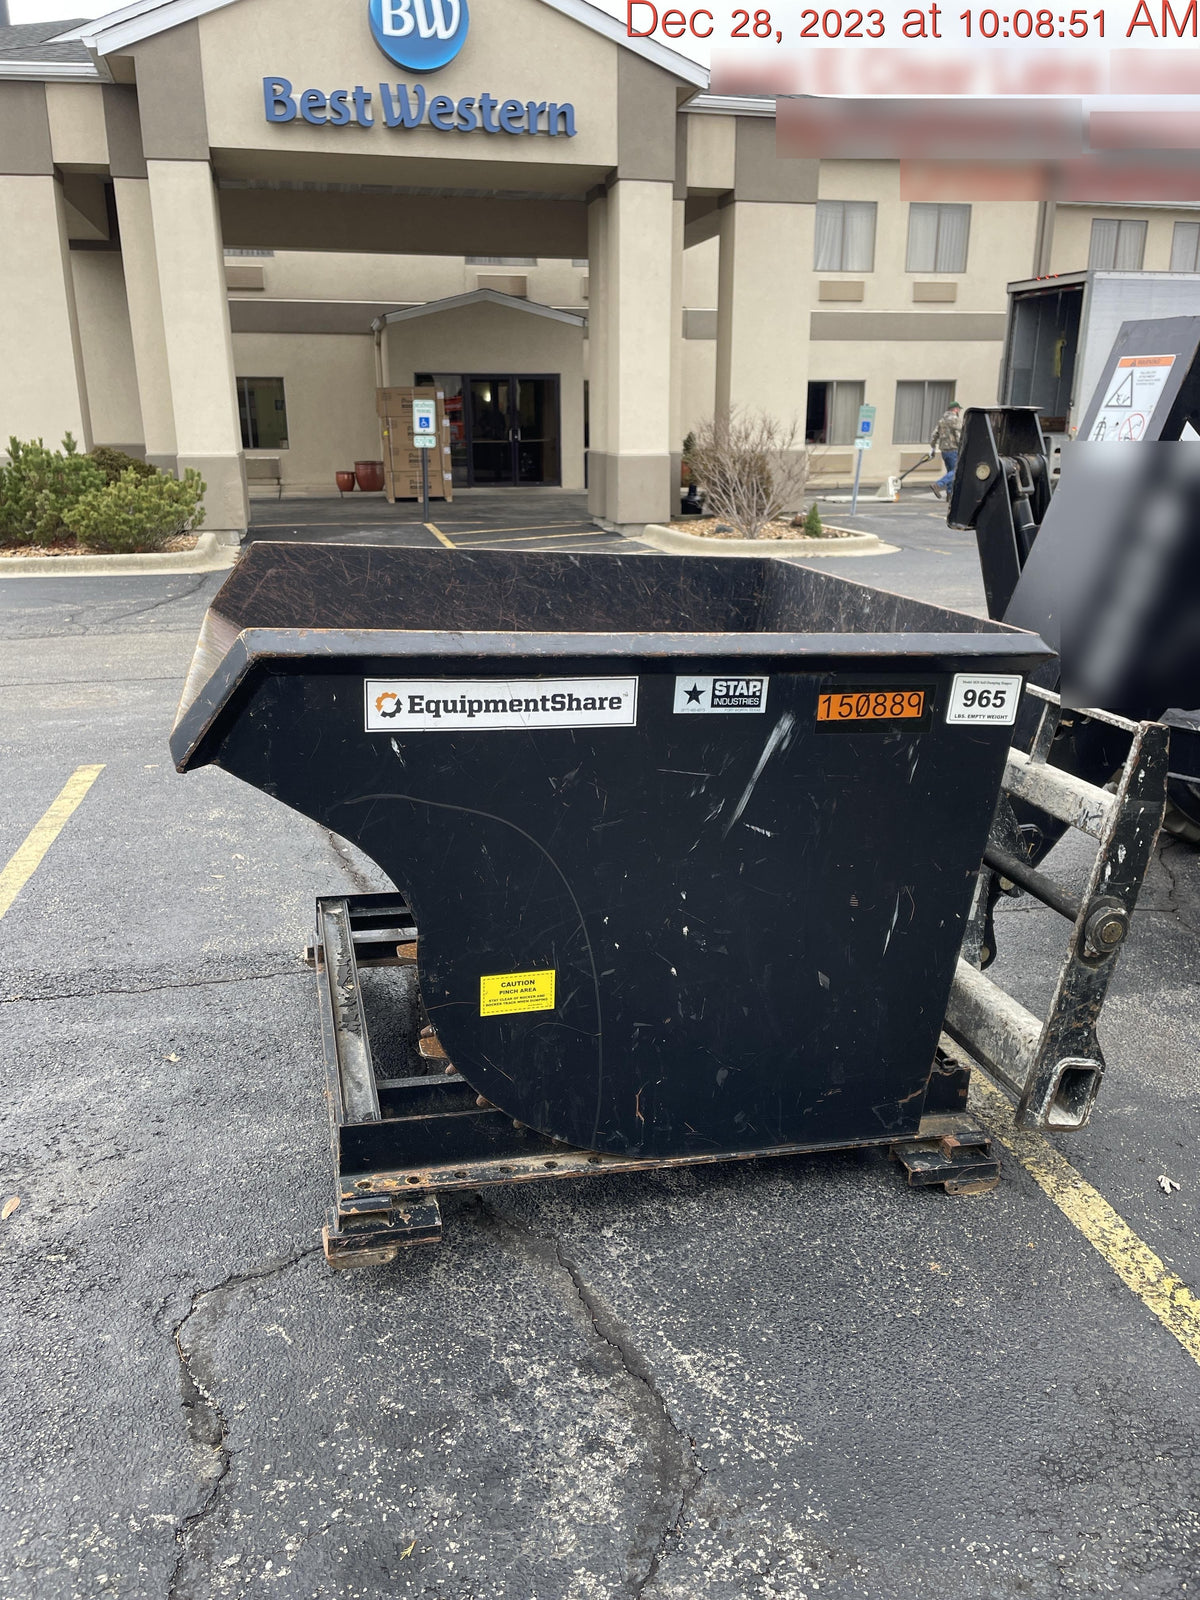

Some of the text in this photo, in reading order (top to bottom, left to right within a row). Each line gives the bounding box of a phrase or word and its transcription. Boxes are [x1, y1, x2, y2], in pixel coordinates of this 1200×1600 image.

[381, 0, 461, 40] BW
[262, 76, 578, 138] Best Western
[714, 680, 761, 696] STAR
[962, 688, 1007, 709] 965
[407, 693, 623, 718] EquipmentShare
[713, 697, 760, 706] INDUSTRIES
[822, 692, 923, 719] 150889
[501, 979, 536, 988] CAUTION
